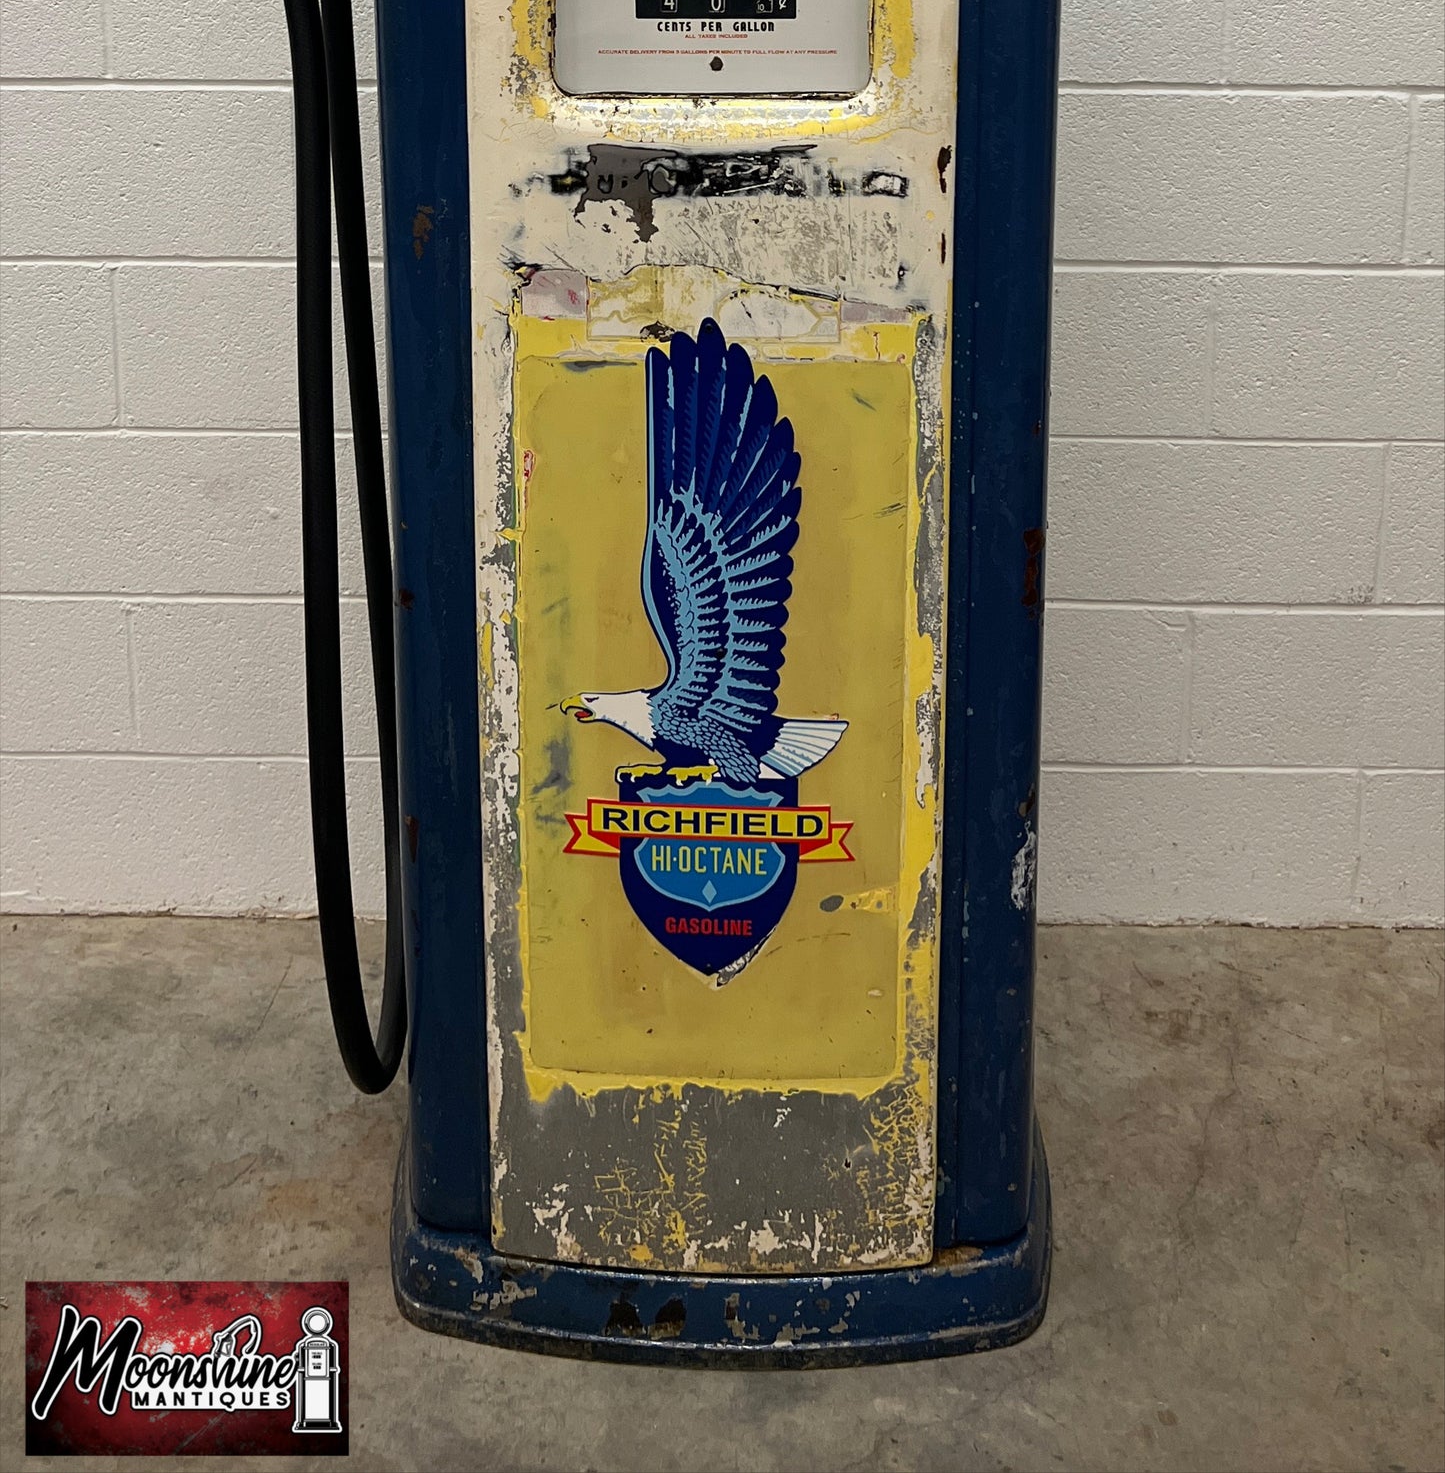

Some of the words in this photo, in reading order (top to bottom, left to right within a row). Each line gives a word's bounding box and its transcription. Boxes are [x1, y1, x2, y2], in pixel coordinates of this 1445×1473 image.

[657, 21, 692, 32] CENTS
[701, 21, 722, 32] PER
[733, 21, 775, 32] GALLON
[602, 807, 824, 838] RICHFIELD
[665, 917, 753, 936] GASOLINE
